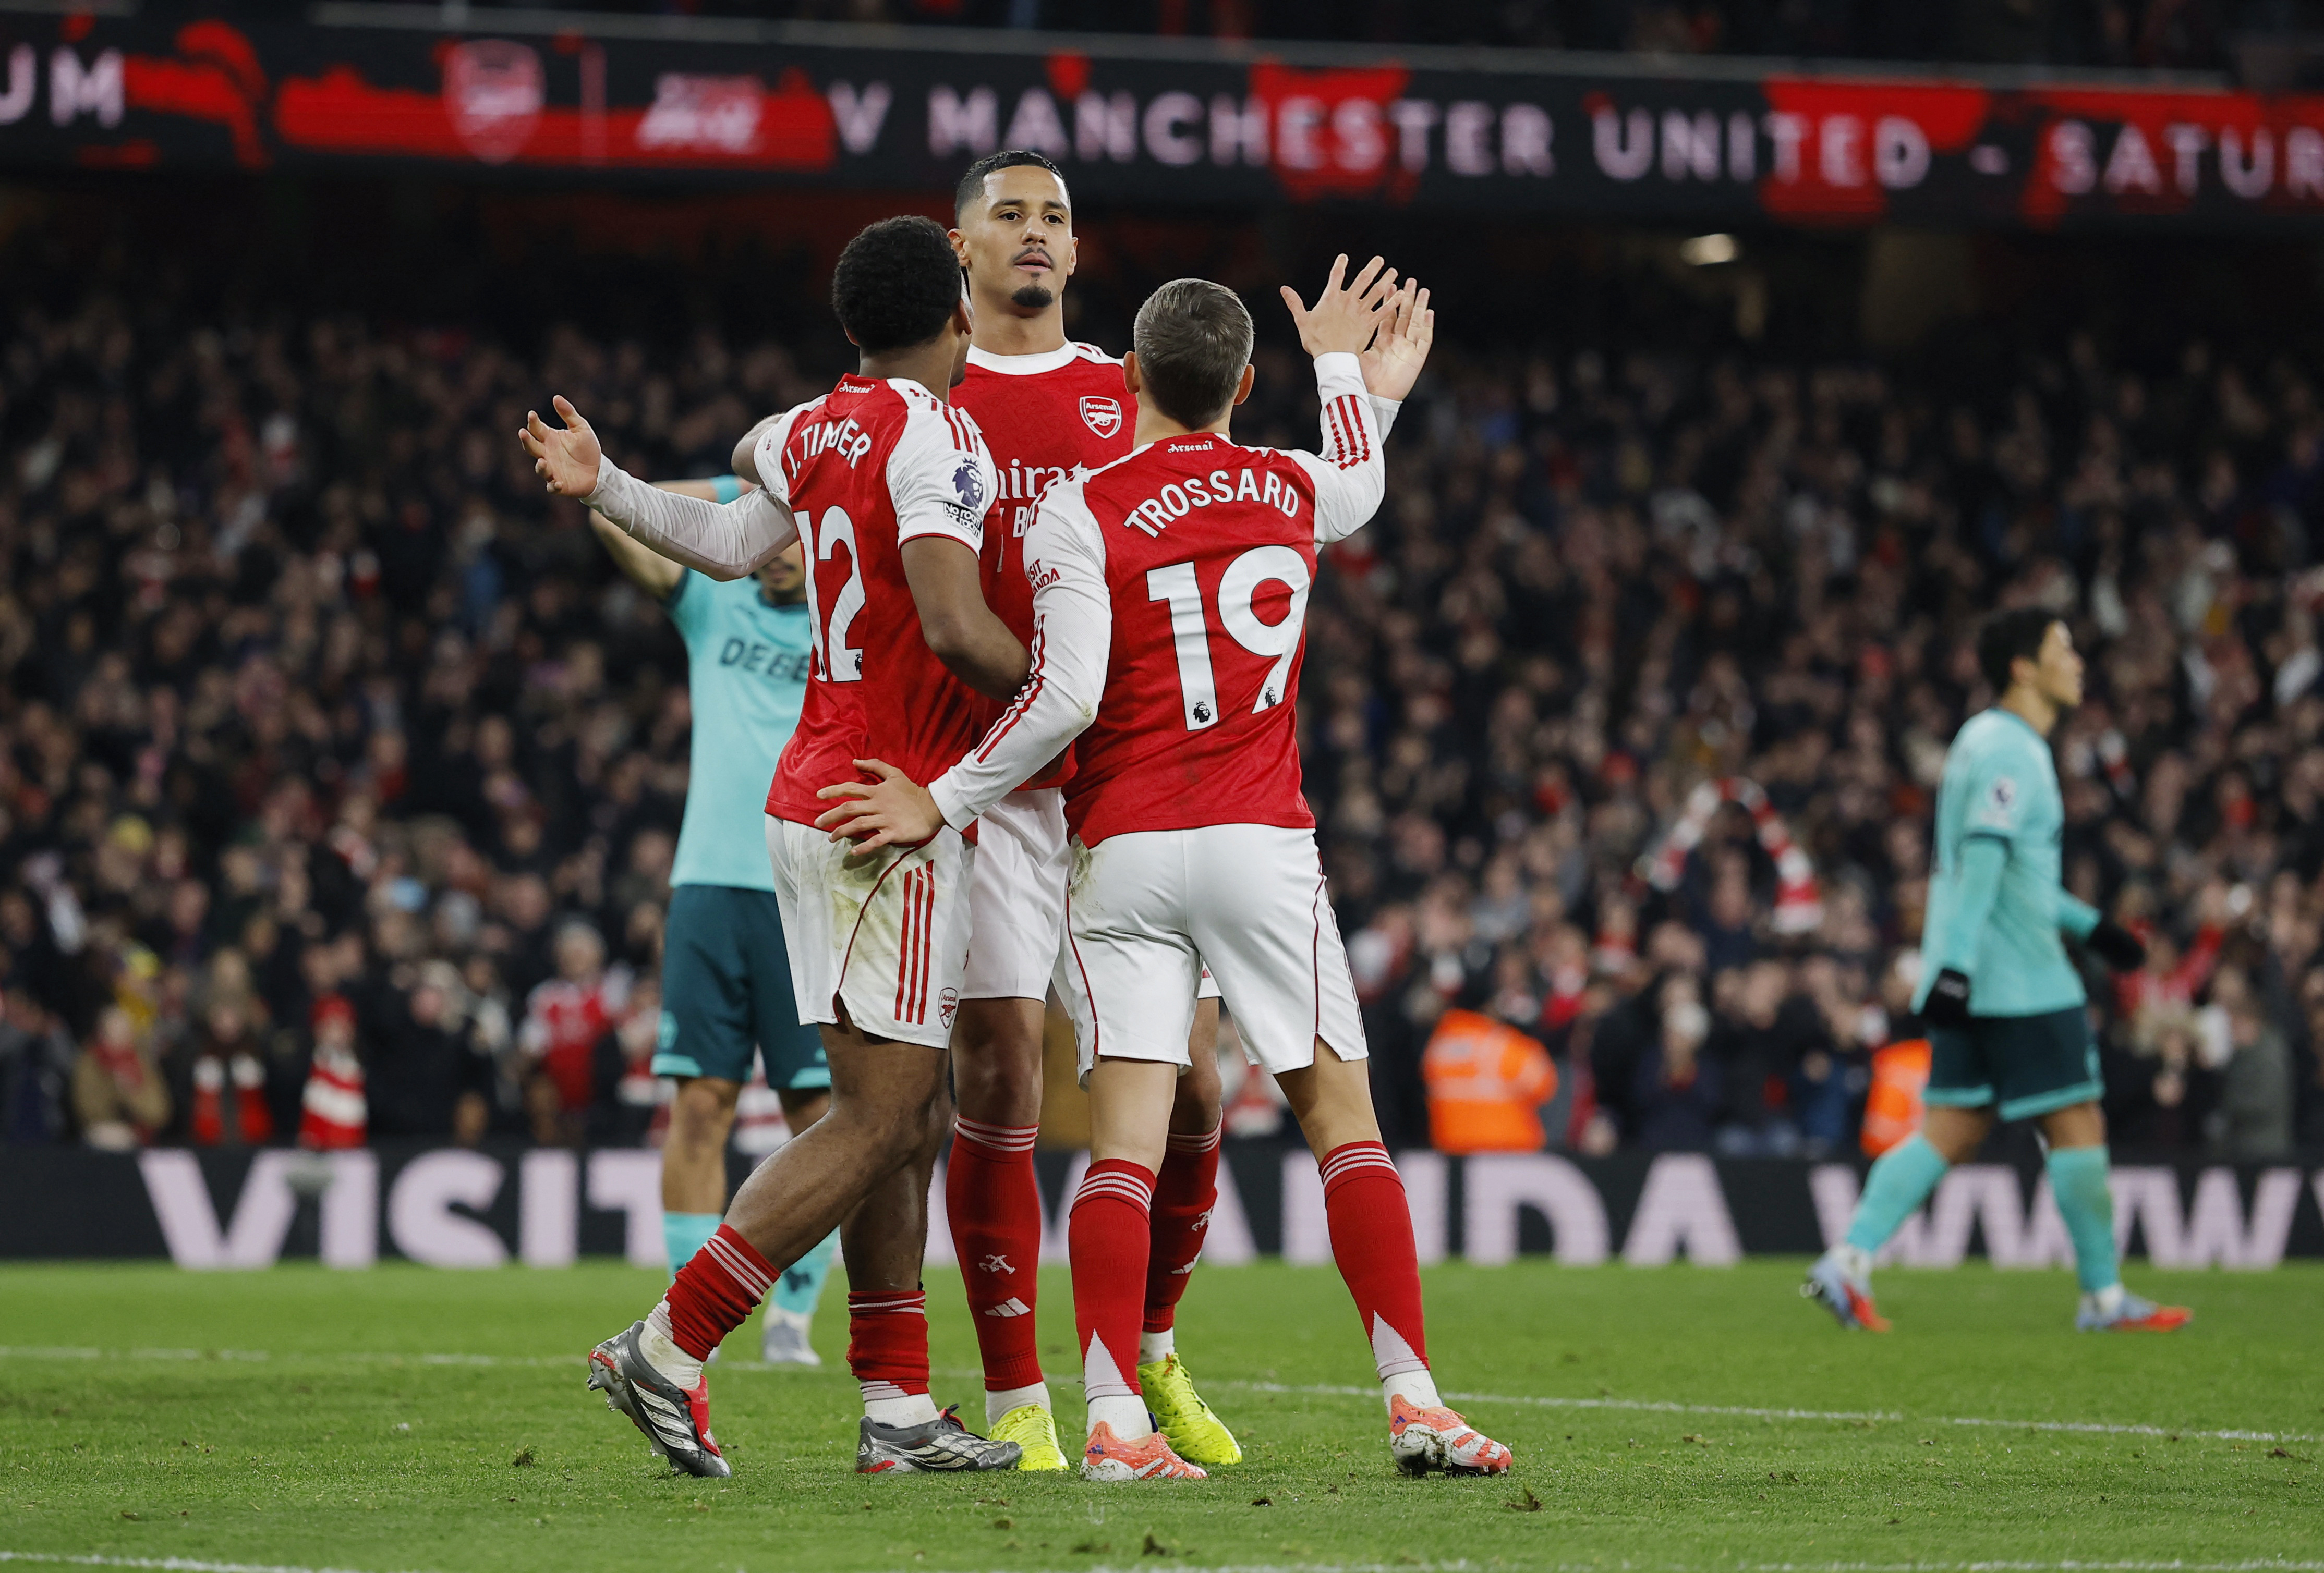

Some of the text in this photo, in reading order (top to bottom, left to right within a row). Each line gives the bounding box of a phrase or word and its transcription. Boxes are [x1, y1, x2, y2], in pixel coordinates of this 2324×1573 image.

[828, 80, 891, 155] V
[927, 82, 1557, 178] MANCHESTER
[1592, 105, 1932, 190] UNITED
[1086, 402, 1116, 411] Arsenal
[1167, 440, 1214, 453] Arsenal
[943, 502, 960, 515] No
[1123, 468, 1300, 539] TROSSARD
[793, 504, 866, 683] 12
[1146, 544, 1311, 732] 19
[136, 1148, 671, 1271] VISIT
